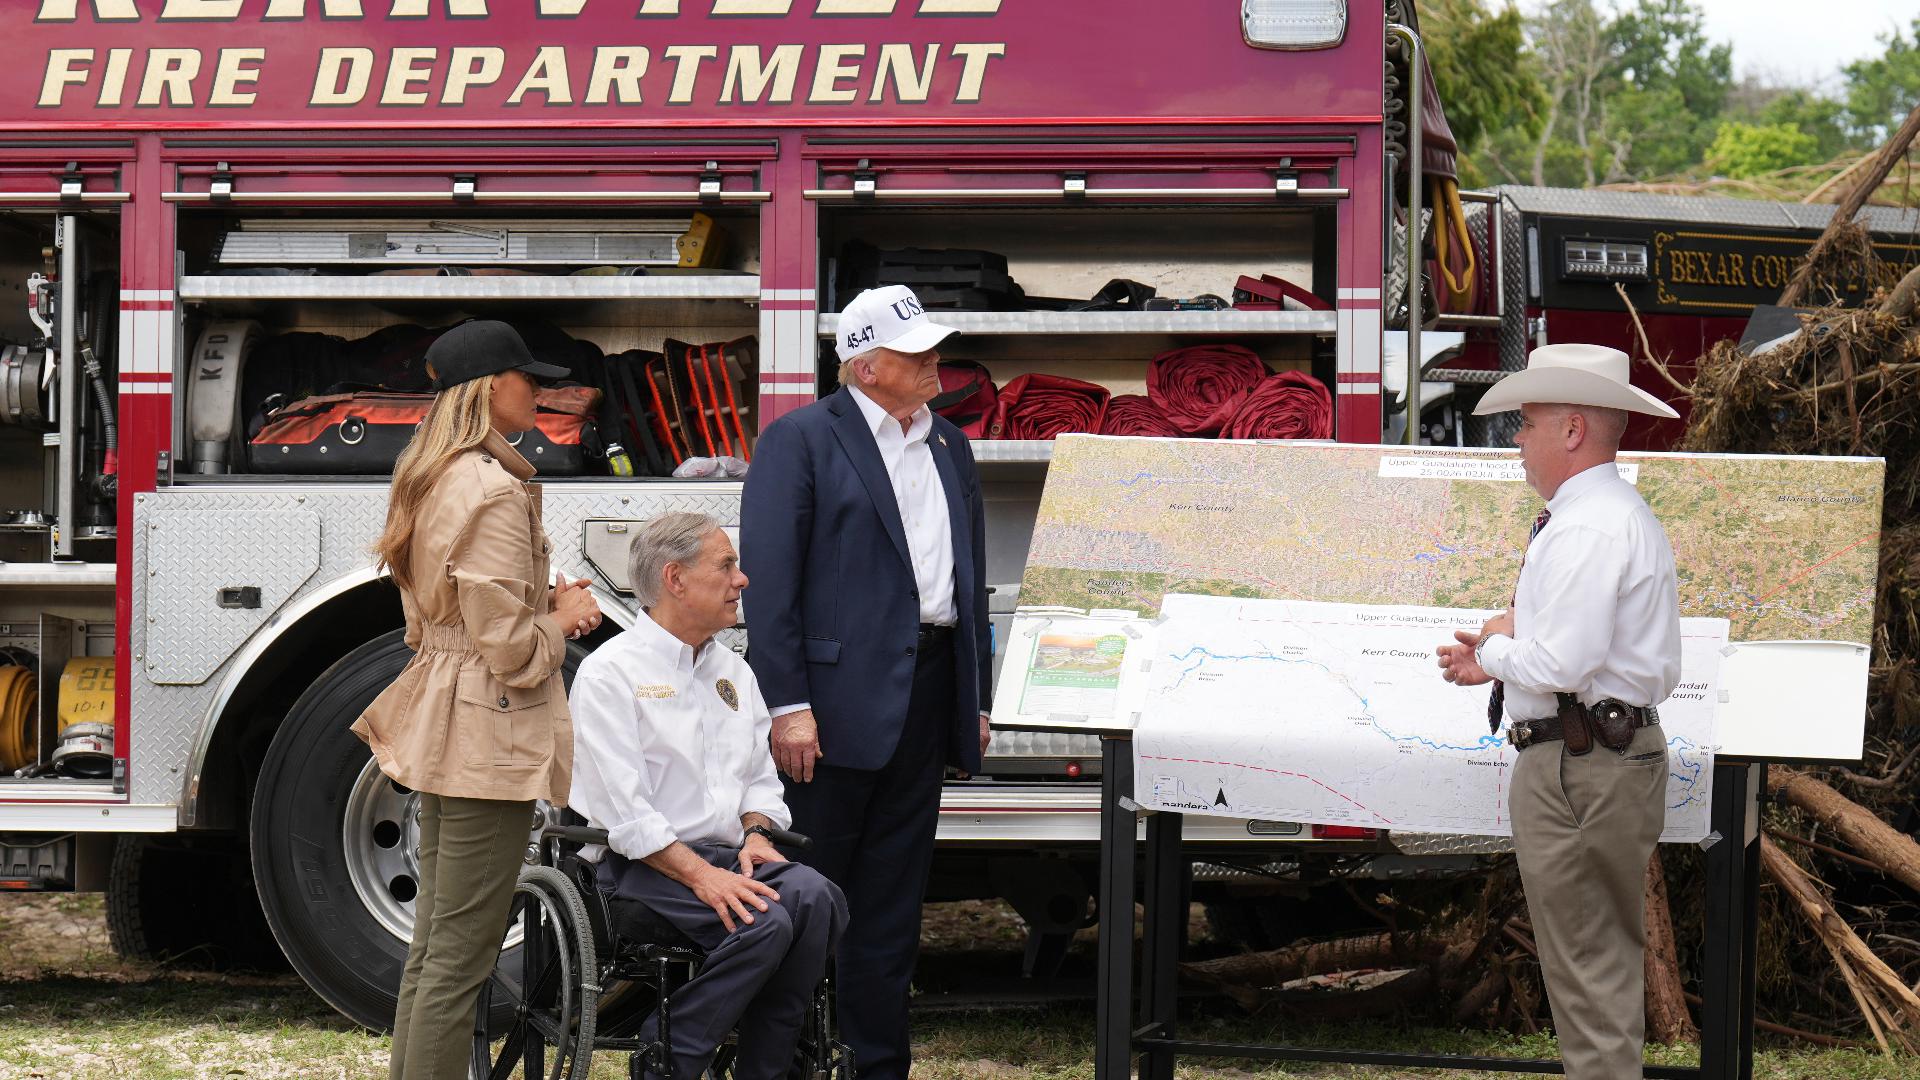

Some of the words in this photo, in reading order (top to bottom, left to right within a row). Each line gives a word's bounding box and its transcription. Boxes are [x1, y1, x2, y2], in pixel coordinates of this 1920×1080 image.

[36, 47, 266, 108] FIRE
[307, 43, 1006, 108] DEPARTMENT
[1669, 250, 1747, 286] BEXAR
[847, 325, 875, 350] 45-47
[200, 334, 229, 381] KFD
[1464, 451, 1504, 459] County
[1388, 459, 1418, 467] Upper
[1422, 460, 1477, 470] Guadalupe
[1821, 496, 1864, 504] County
[1169, 503, 1192, 511] Kerr
[1195, 504, 1235, 513] County
[1088, 588, 1128, 596] County
[1356, 613, 1387, 622] Upper
[1390, 614, 1448, 625] Guadalupe
[1361, 648, 1387, 656] Kerr
[1389, 649, 1431, 660] County
[1675, 682, 1708, 690] ndall
[1669, 692, 1706, 701] ounty
[1467, 759, 1492, 767] Division
[1494, 760, 1509, 768] Echo
